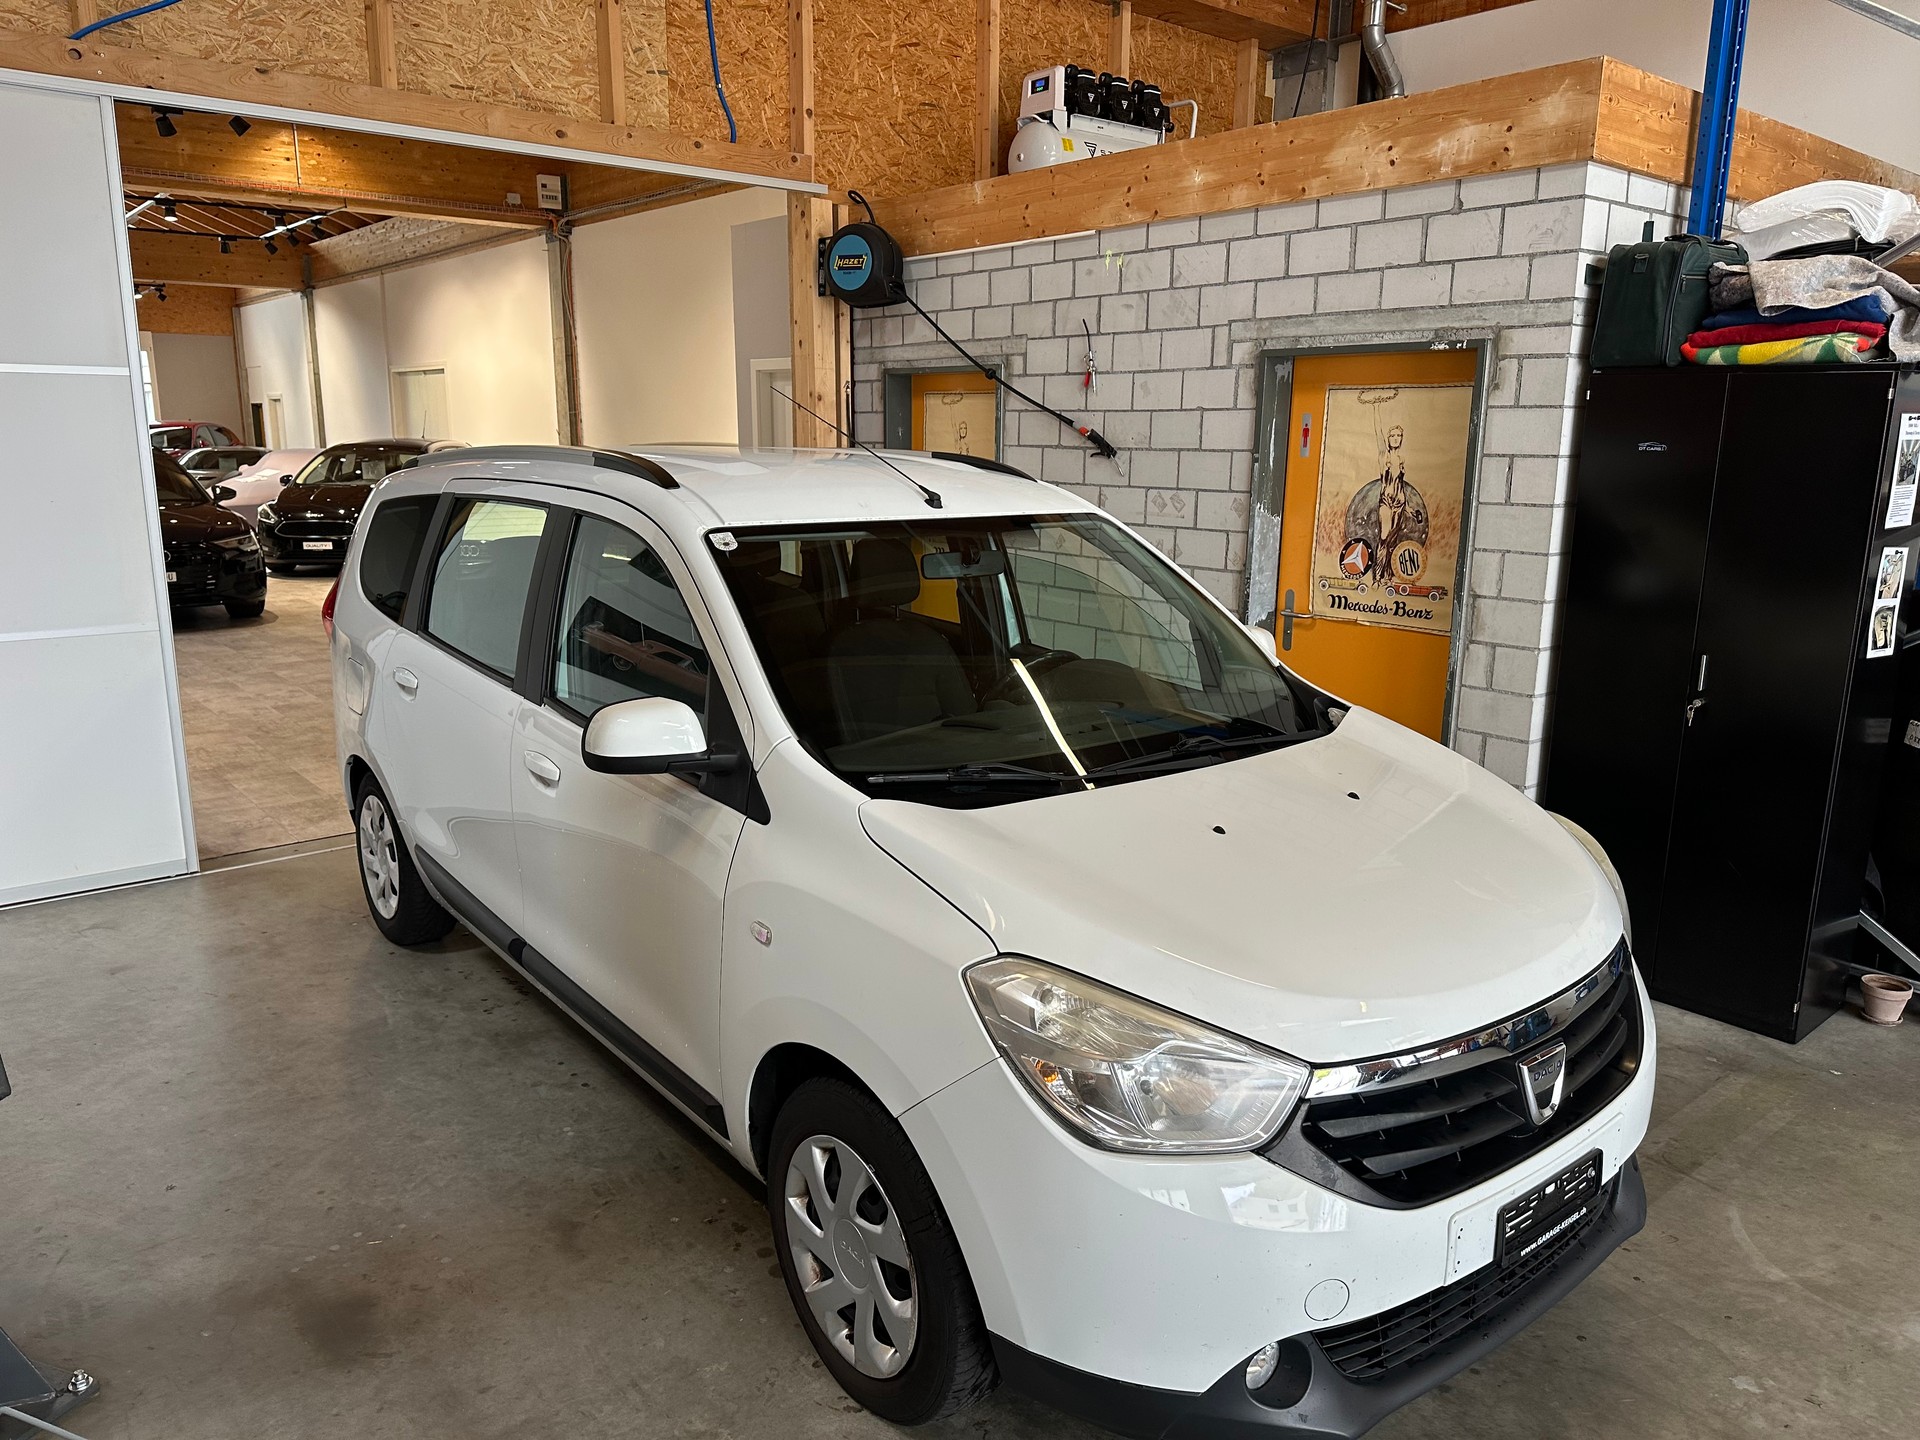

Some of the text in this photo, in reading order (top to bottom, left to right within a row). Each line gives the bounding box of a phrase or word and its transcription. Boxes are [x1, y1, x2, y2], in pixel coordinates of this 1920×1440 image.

[835, 256, 865, 269] HAZET
[1339, 563, 1364, 580] MERCEDES
[1398, 547, 1420, 577] BENZ
[1327, 593, 1434, 620] Mercedes-Benz
[1533, 1059, 1564, 1083] DACIA
